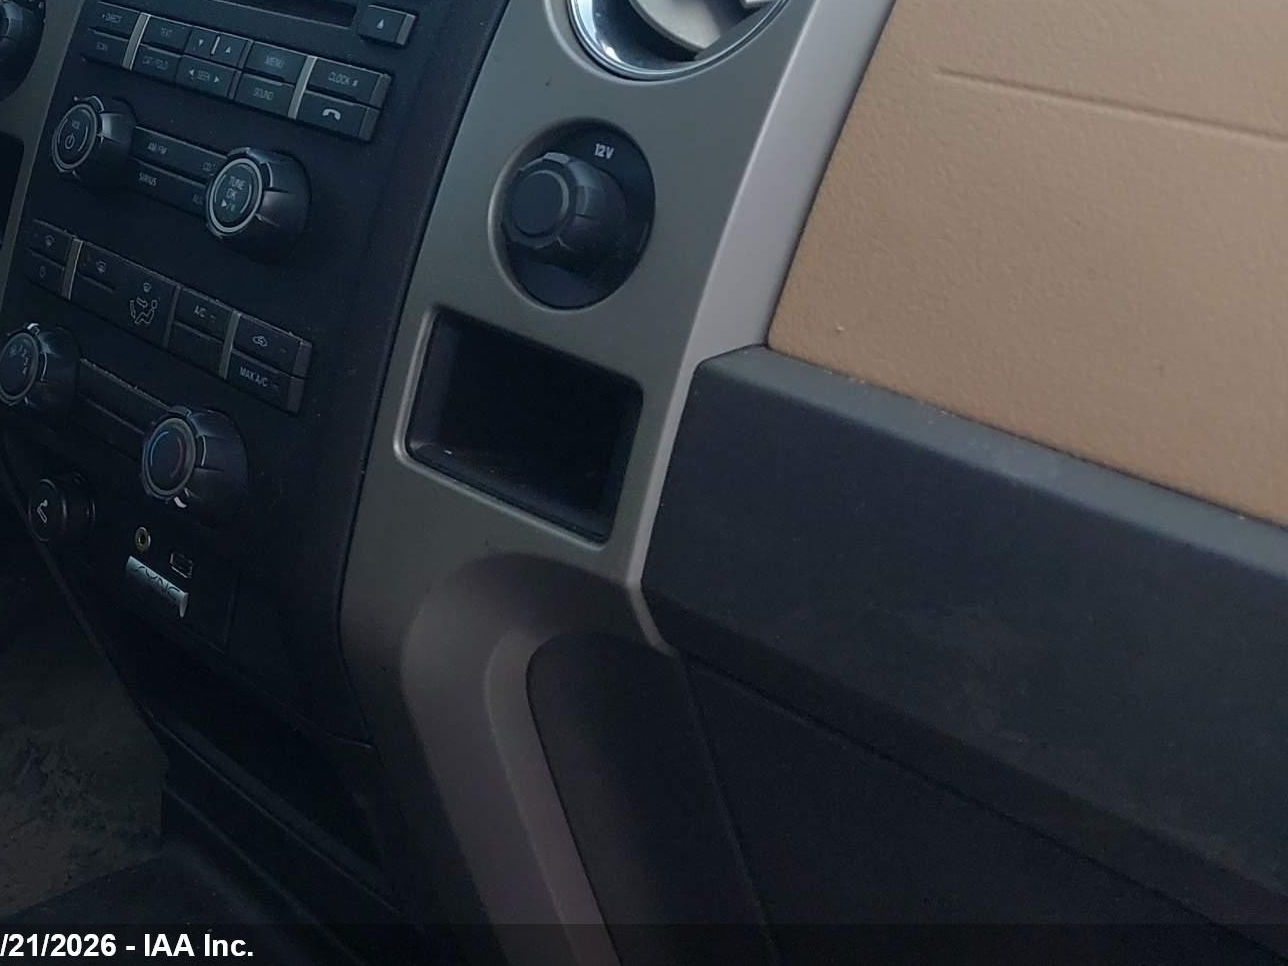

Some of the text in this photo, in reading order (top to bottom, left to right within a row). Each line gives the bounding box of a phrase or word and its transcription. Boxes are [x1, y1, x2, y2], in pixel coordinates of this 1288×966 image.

[328, 70, 350, 87] CLOCK
[253, 86, 275, 102] SOUND
[594, 142, 614, 160] 12V
[138, 171, 158, 187] SIRIUS
[230, 175, 247, 190] TUNE
[226, 187, 238, 200] OK
[194, 304, 206, 319] A/C
[239, 365, 269, 388] MAX A/C
